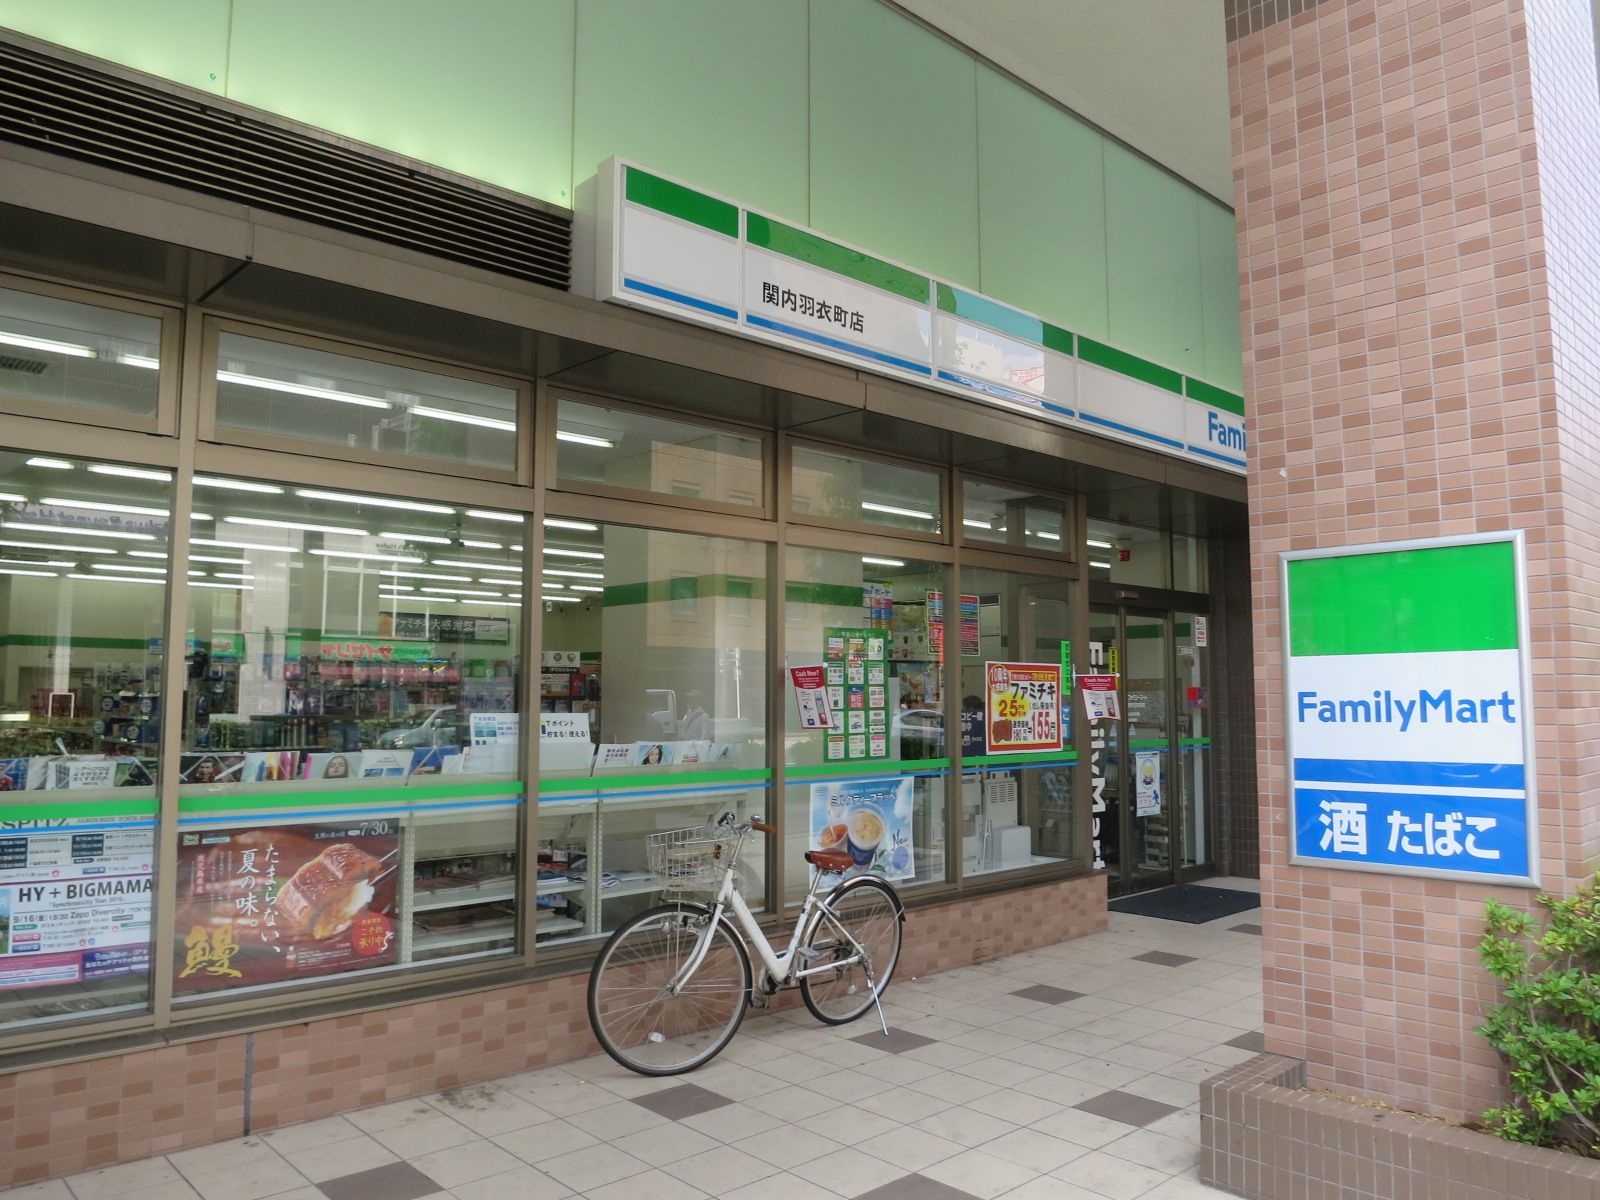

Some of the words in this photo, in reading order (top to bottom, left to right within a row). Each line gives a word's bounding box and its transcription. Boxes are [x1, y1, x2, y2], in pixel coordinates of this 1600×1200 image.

[762, 281, 864, 333] 関内羽衣町店
[1010, 682, 1056, 701] ファミチキ
[1298, 690, 1516, 732] FamilyMart
[893, 829, 909, 847] New
[1319, 800, 1368, 855] 酒
[1387, 811, 1501, 860] たばこ
[18, 886, 46, 903] HY
[49, 887, 61, 899] +
[66, 878, 152, 900] BIGMAMA
[236, 848, 260, 928] 夏の味。
[261, 843, 280, 953] たまらない、
